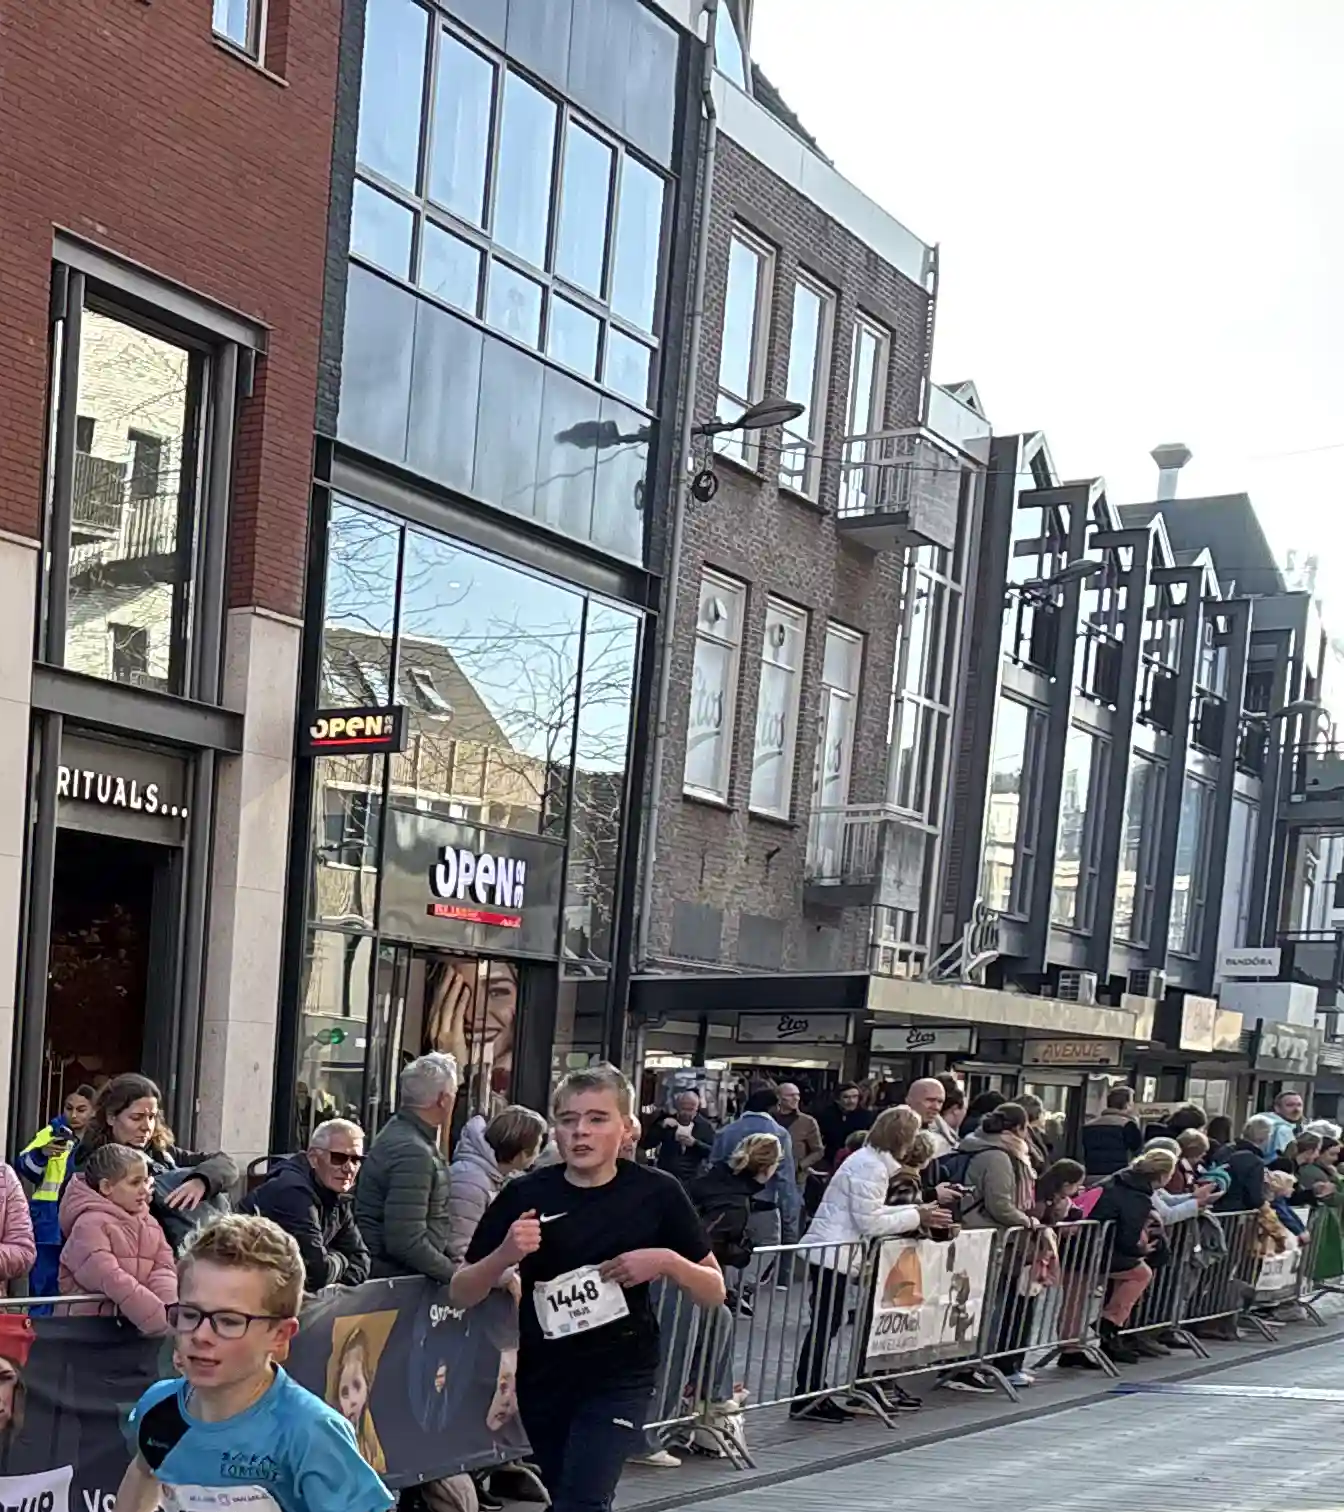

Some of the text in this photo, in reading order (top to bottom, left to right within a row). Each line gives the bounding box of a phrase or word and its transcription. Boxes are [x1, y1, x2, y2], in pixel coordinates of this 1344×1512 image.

[56, 765, 188, 818] RITUALS...
[777, 1014, 810, 1034] Etos
[906, 1028, 936, 1045] Etos
[1043, 1043, 1103, 1058] AVENUE
[547, 1279, 599, 1313] 1448
